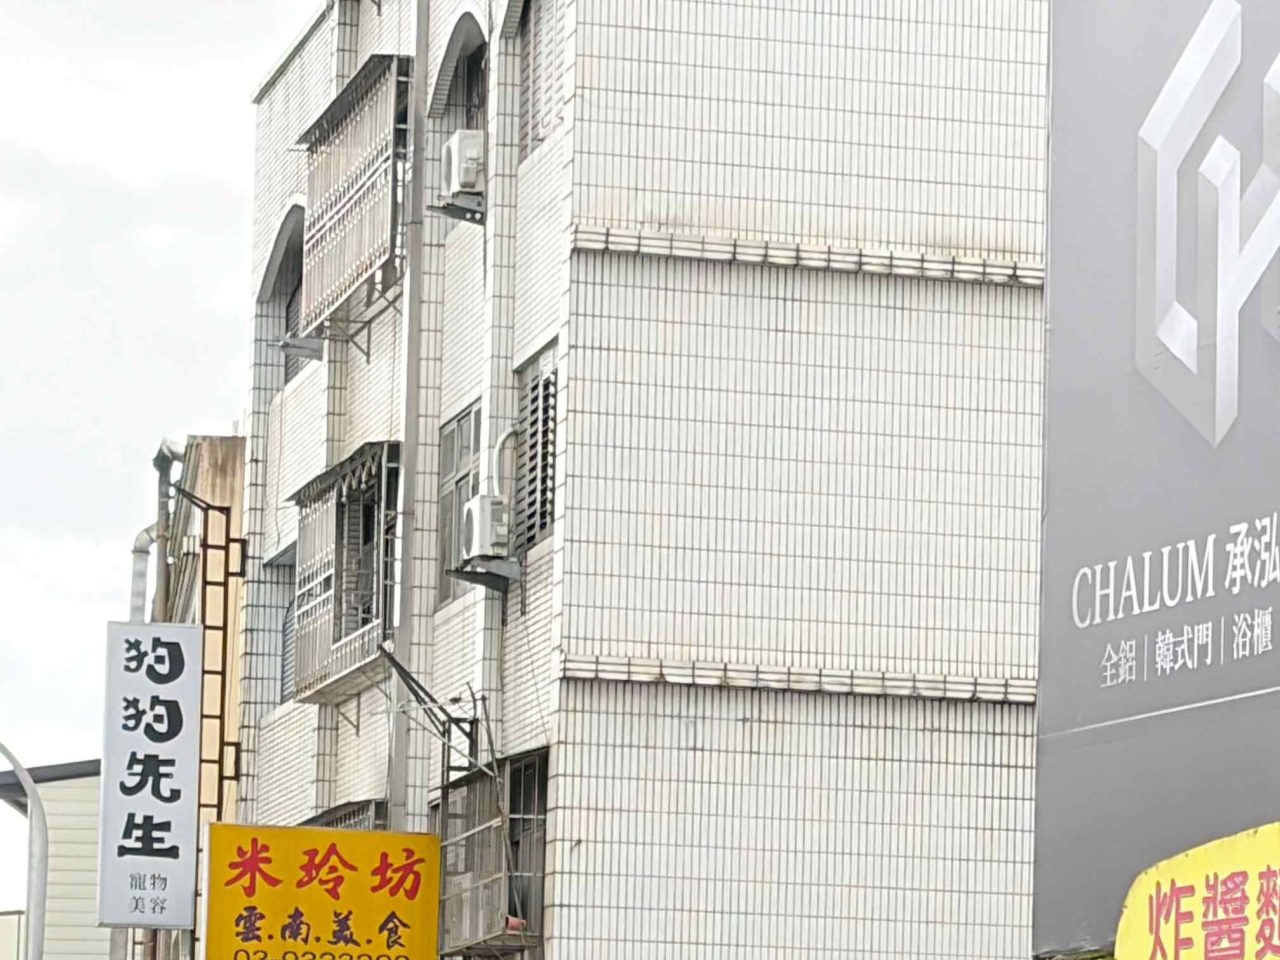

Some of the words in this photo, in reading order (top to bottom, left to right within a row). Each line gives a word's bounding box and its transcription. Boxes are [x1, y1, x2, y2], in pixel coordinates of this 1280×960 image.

[1071, 533, 1217, 629] CHALUM
[1155, 620, 1213, 677] 韓式門
[1231, 606, 1274, 660] 浴櫃
[116, 636, 187, 860] 狗狗先生
[129, 872, 168, 892] 寵物
[224, 837, 426, 901] 米玲坊
[128, 895, 168, 914] 美容
